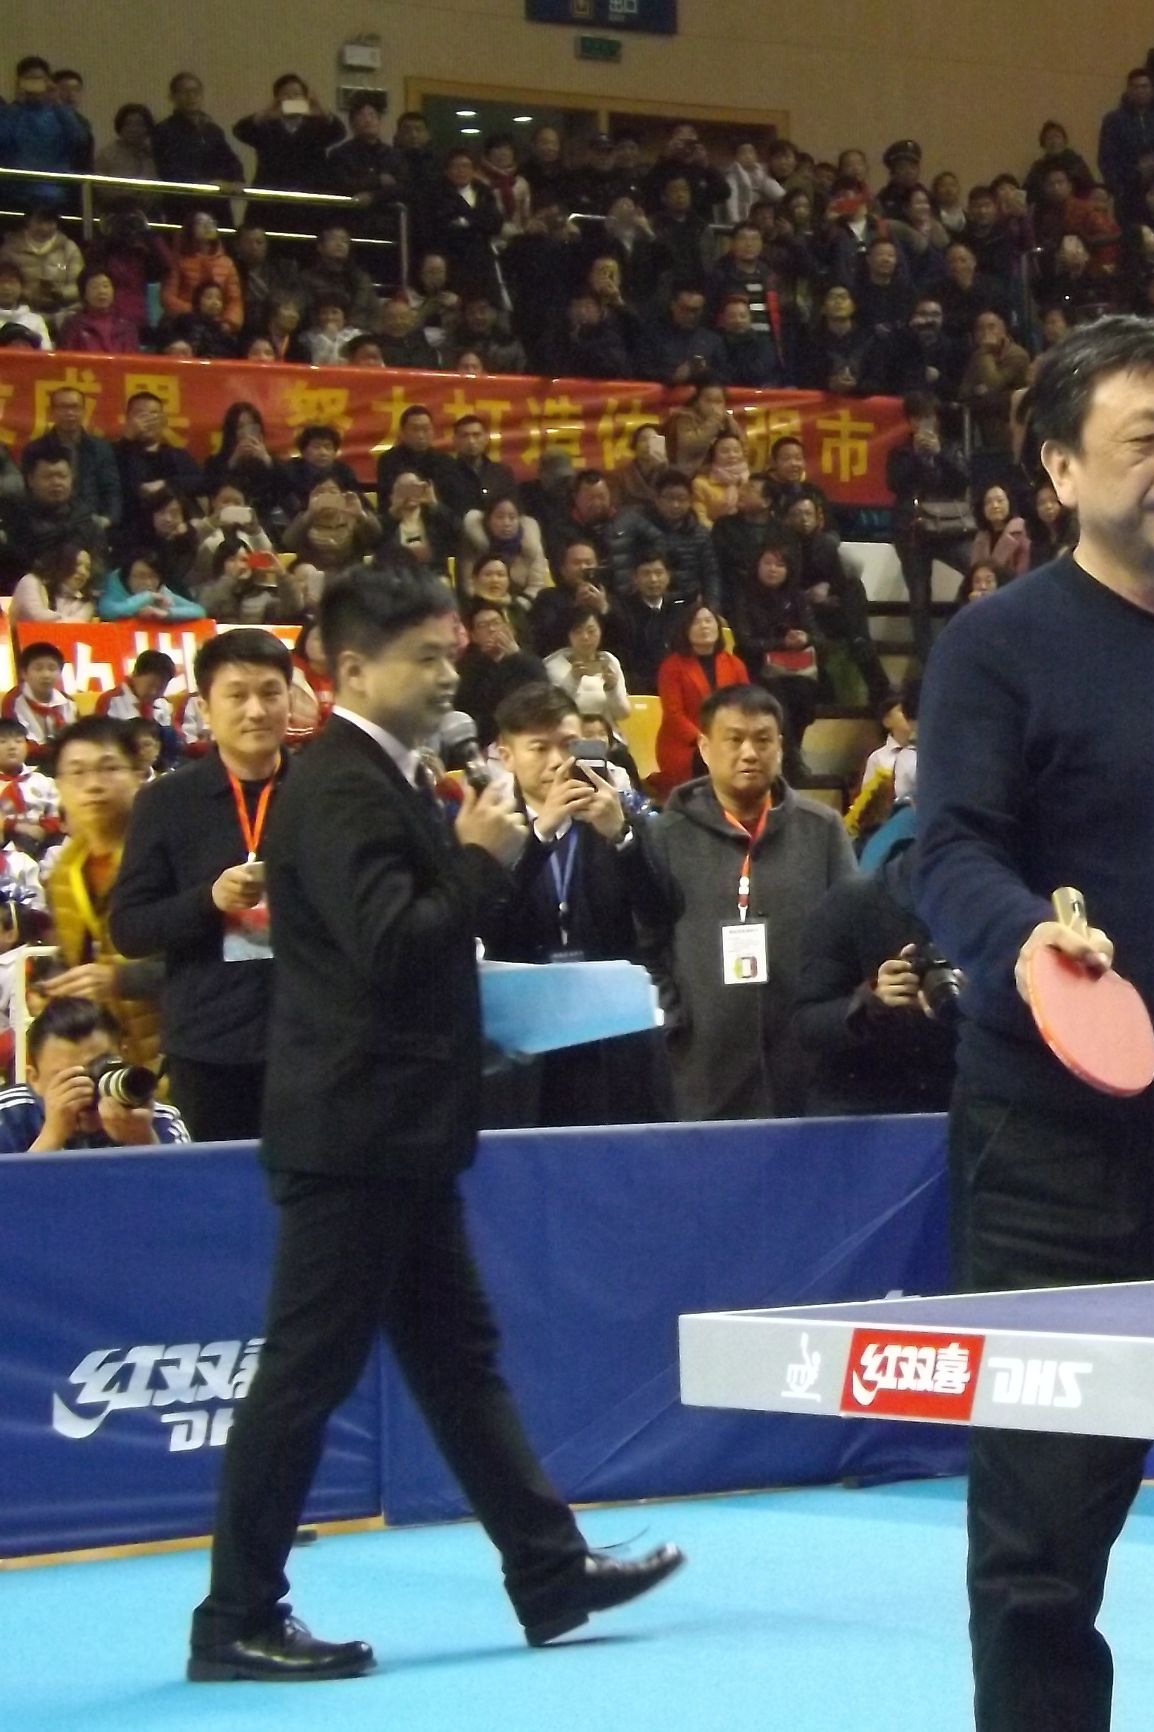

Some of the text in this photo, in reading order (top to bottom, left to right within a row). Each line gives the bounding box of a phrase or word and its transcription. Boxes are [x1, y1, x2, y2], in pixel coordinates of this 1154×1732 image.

[852, 1342, 1093, 1408] 红双喜 DHS
